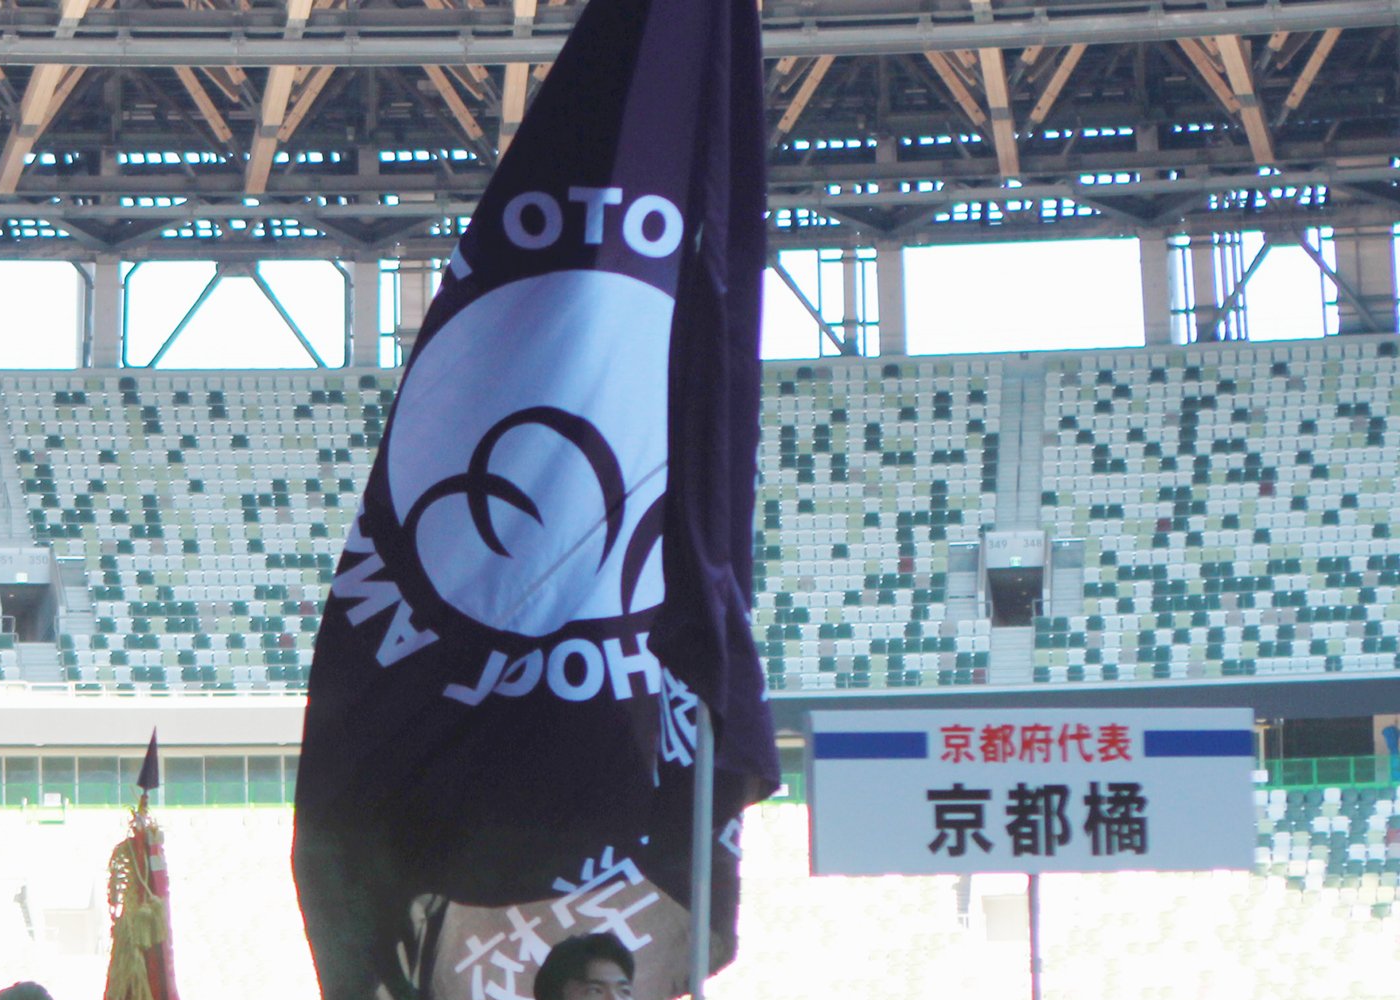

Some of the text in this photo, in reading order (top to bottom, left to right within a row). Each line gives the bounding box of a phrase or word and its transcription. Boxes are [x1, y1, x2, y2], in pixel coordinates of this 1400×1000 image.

[939, 722, 1134, 764] 京都府代表
[925, 781, 1150, 858] 京都橘
